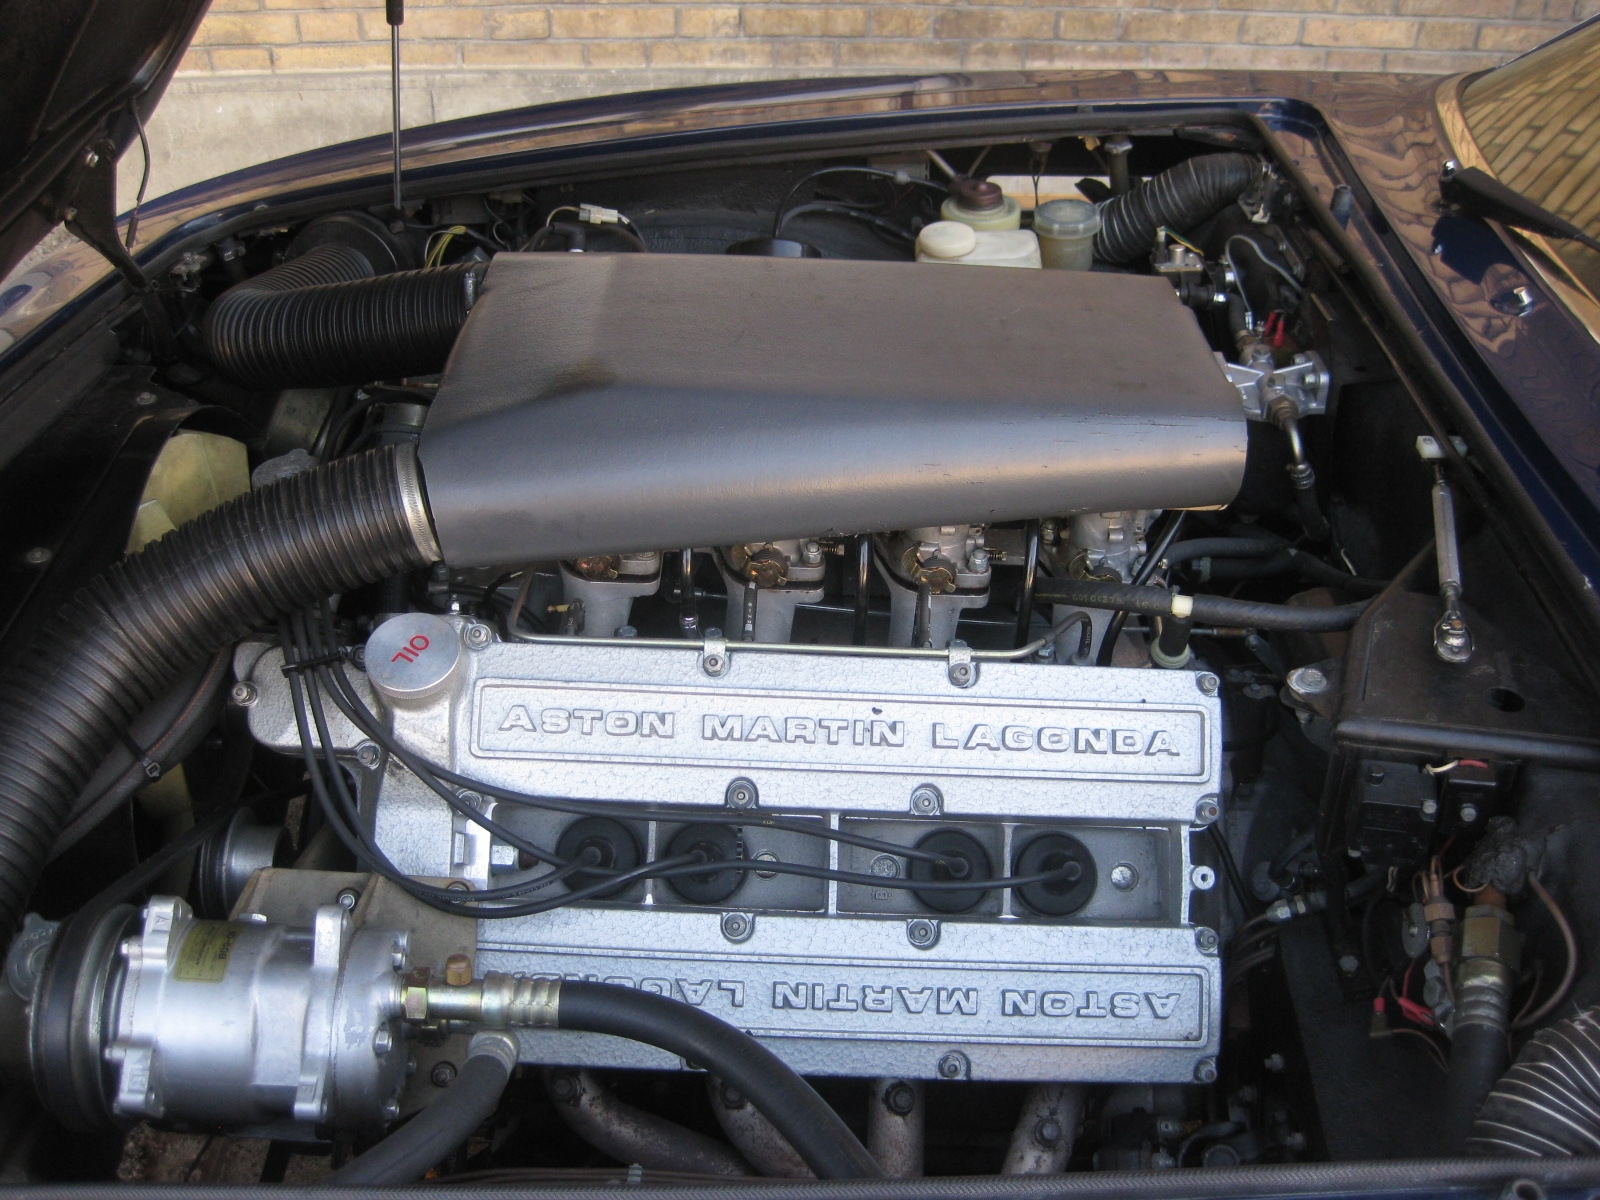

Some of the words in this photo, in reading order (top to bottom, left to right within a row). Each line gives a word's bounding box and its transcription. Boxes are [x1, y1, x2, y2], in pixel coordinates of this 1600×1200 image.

[391, 634, 430, 663] OIL
[499, 704, 676, 739] ASTON
[700, 713, 906, 748] MARTIN
[931, 722, 1181, 757] LAGONDA
[771, 980, 979, 1017] MARTIN
[1000, 988, 1182, 1020] ASTON
